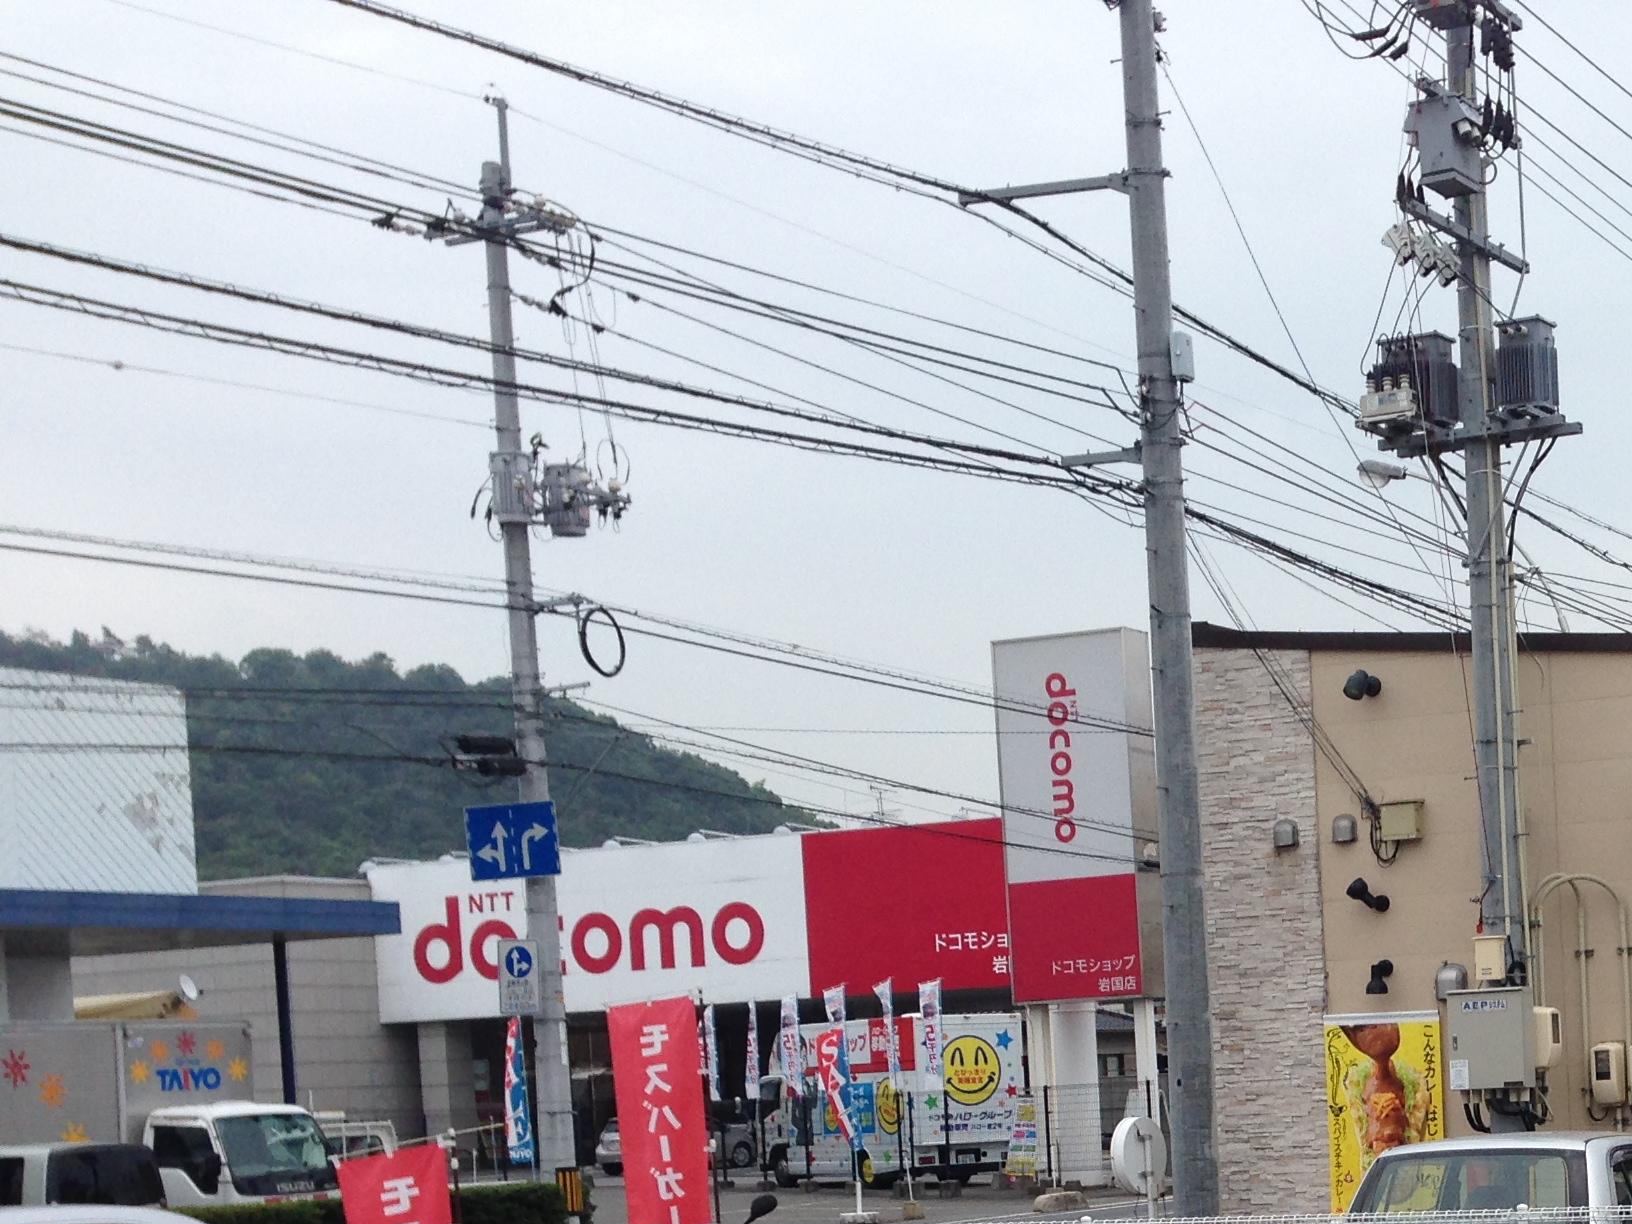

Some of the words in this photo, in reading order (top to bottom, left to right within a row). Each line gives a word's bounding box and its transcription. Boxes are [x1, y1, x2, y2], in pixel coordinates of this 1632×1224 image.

[1044, 671, 1077, 844] docomo
[468, 890, 514, 914] NTT
[413, 894, 765, 985] doomo
[1051, 954, 1136, 976] ドコモショップ
[1097, 975, 1136, 993] 岩国店
[156, 1066, 222, 1092] TAIYO
[276, 1180, 316, 1194] ISUZU
